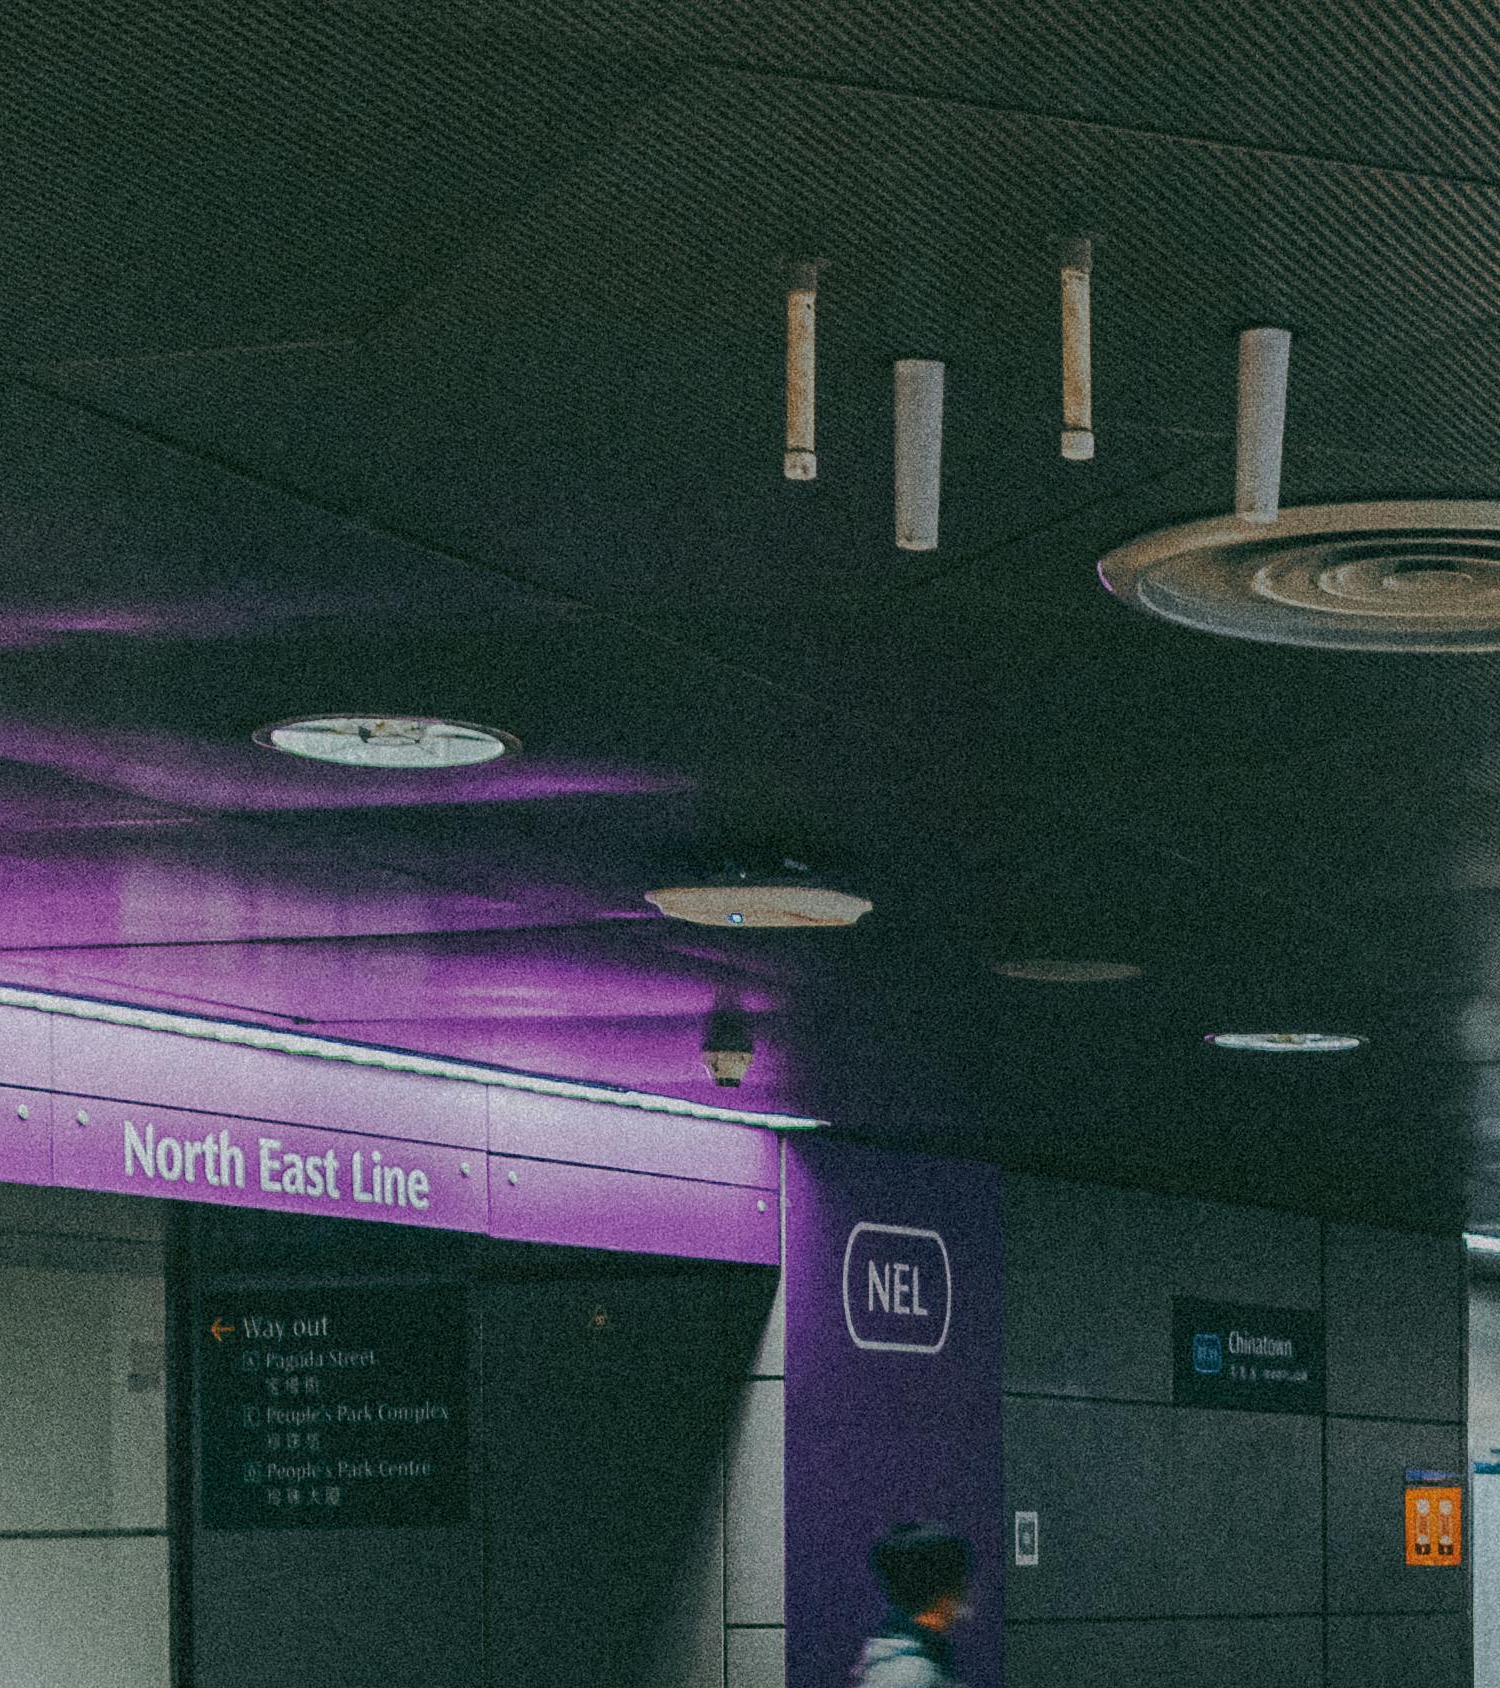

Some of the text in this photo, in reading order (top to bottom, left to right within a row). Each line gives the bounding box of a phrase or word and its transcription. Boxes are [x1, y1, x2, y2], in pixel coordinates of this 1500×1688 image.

[123, 1119, 431, 1212] North East Line
[868, 1259, 929, 1316] NEL
[242, 1315, 329, 1341] Way out
[337, 1402, 373, 1421] Park
[378, 1400, 449, 1425] Complex
[338, 1460, 373, 1479] Park
